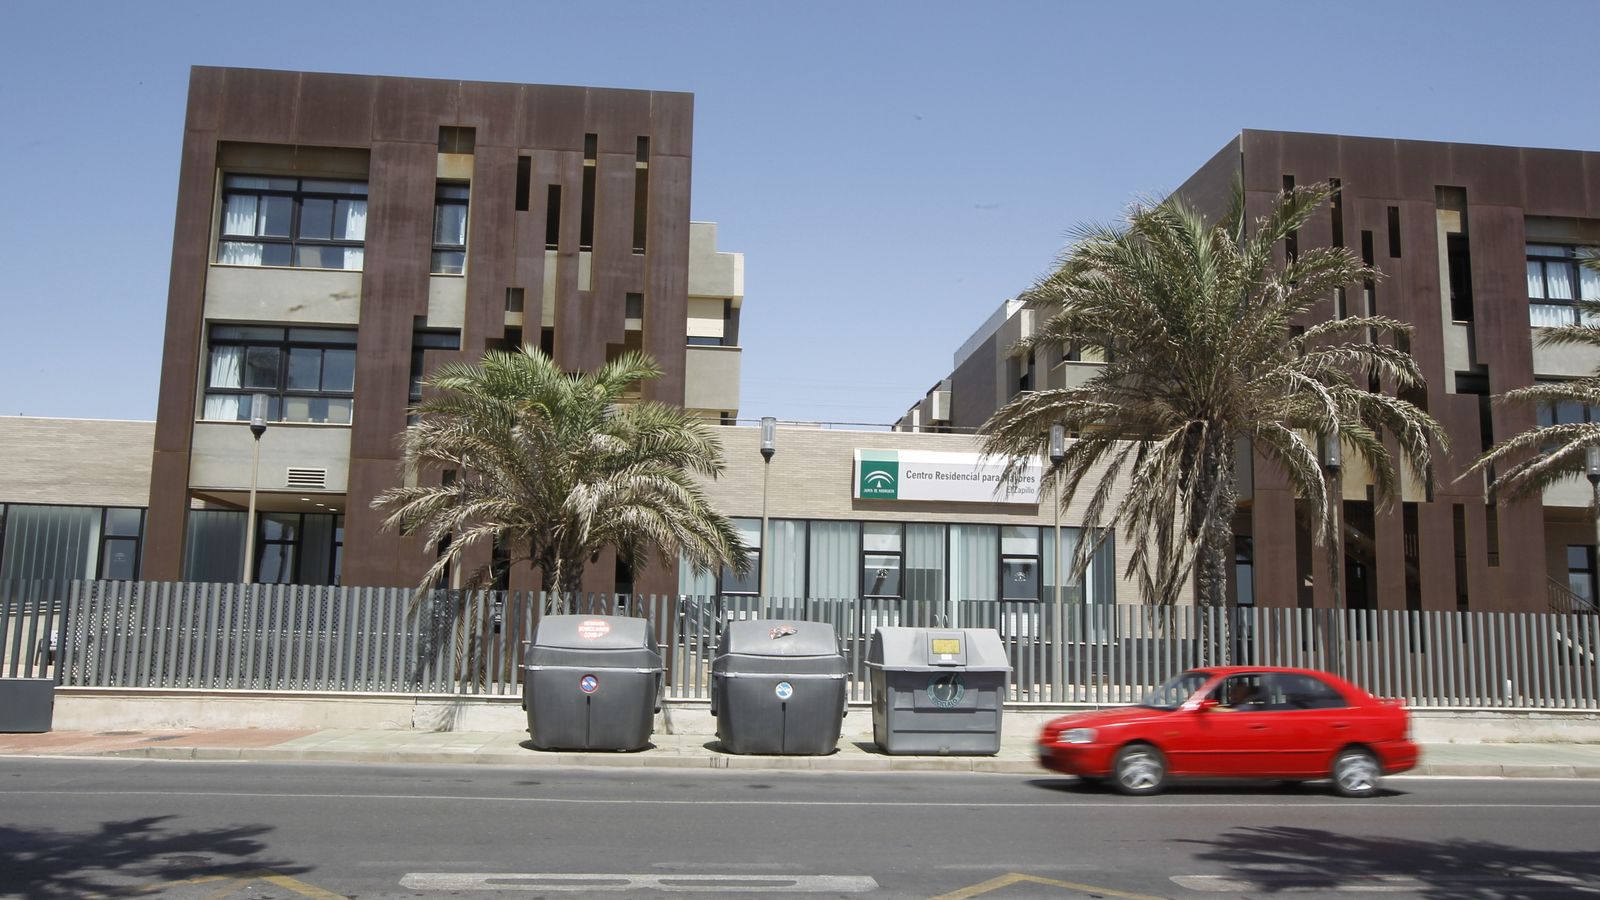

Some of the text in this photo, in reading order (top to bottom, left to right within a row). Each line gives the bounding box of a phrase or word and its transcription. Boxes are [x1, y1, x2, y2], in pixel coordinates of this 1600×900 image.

[906, 470, 933, 479] Centro
[935, 471, 980, 481] Residencial
[982, 474, 1000, 483] para
